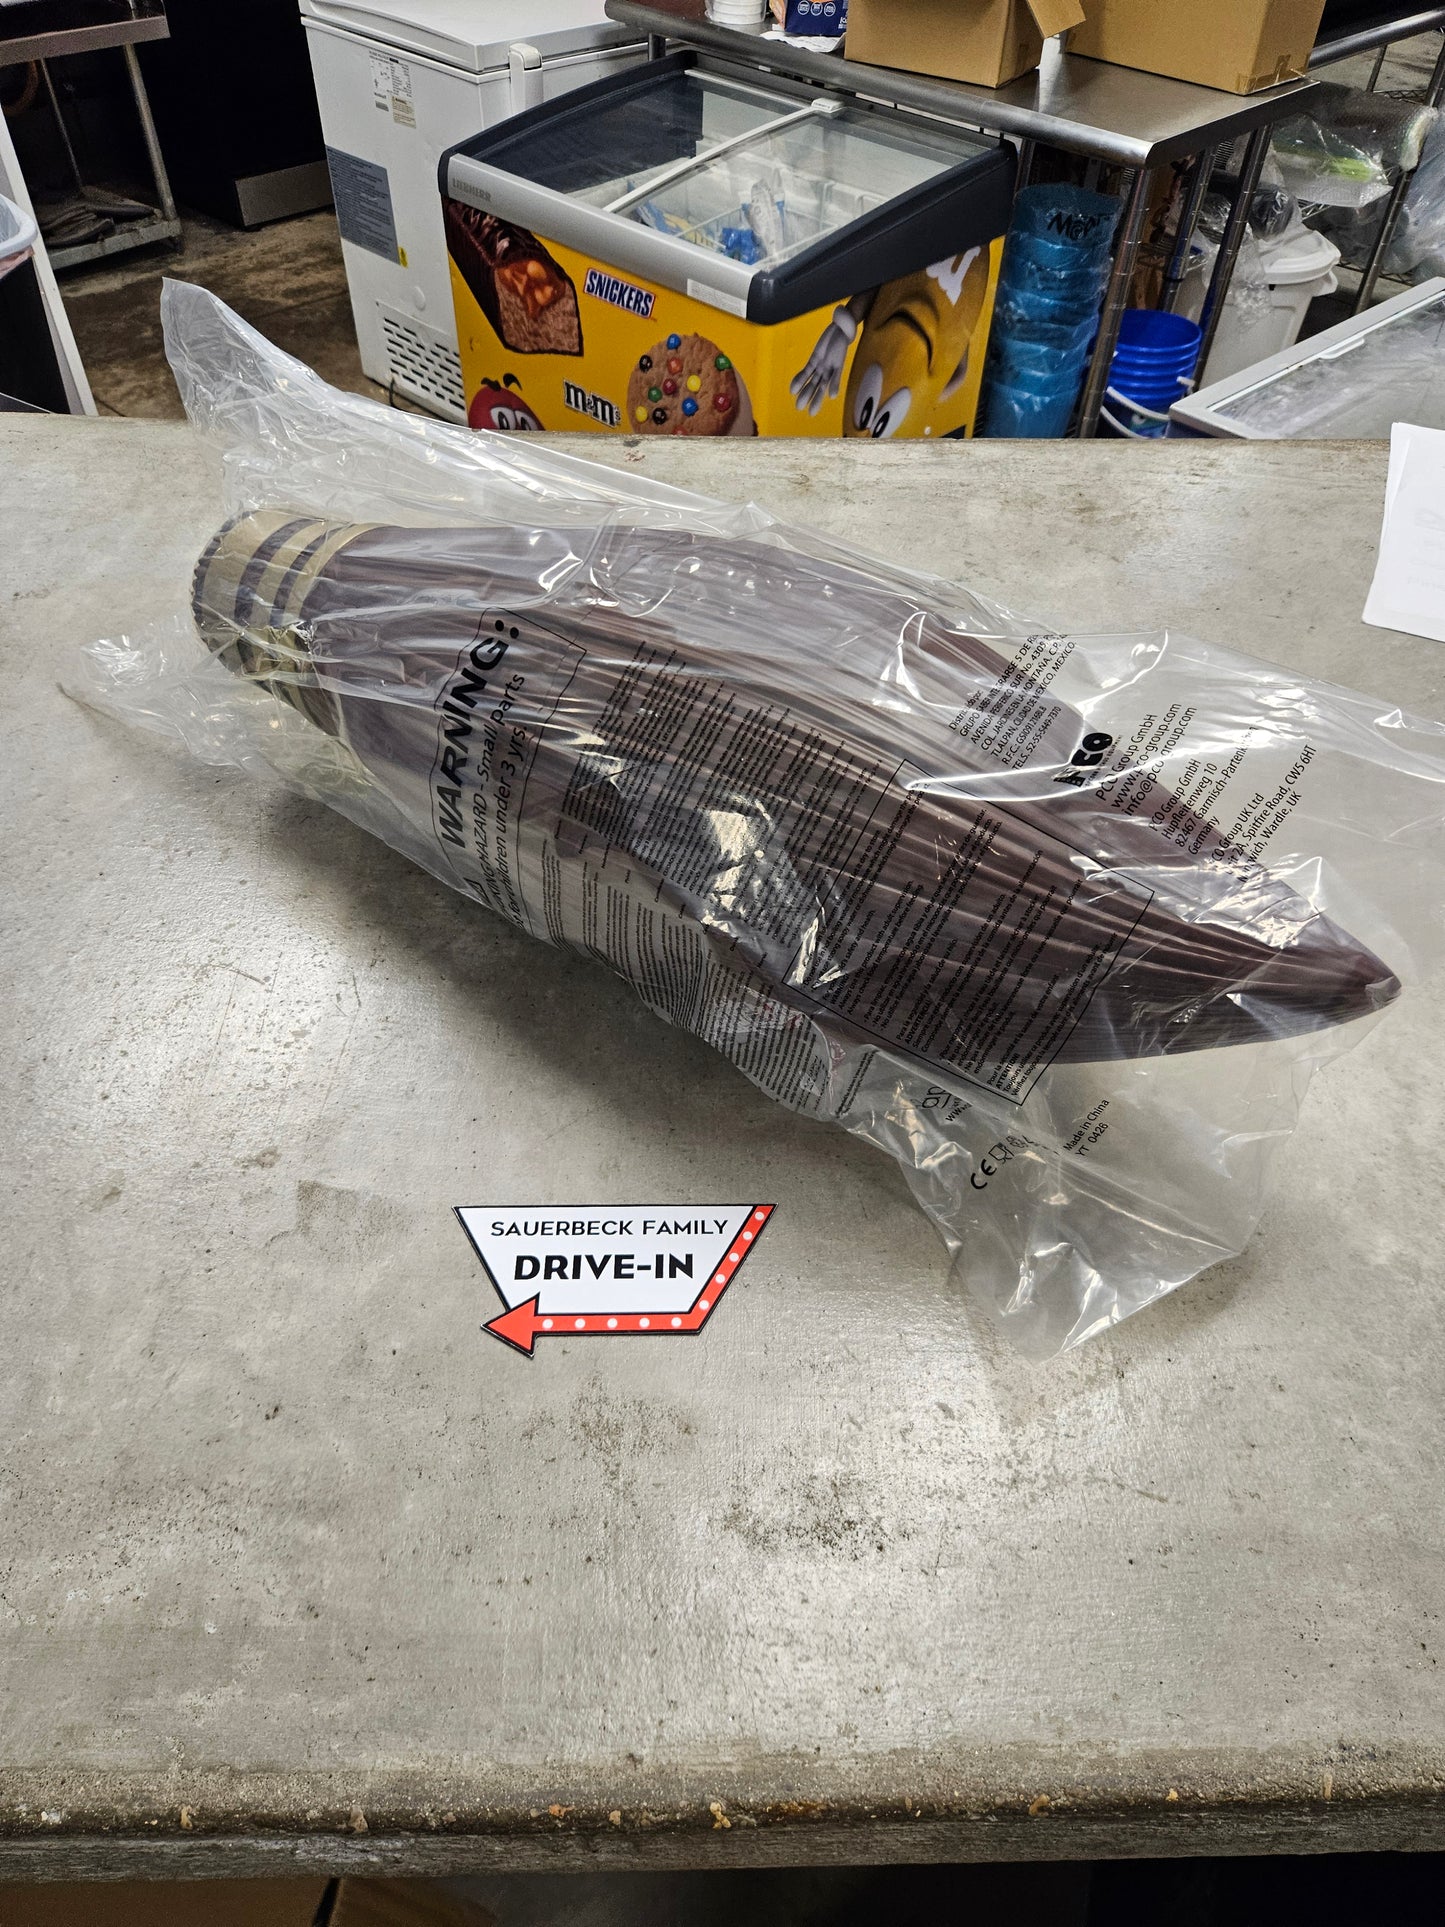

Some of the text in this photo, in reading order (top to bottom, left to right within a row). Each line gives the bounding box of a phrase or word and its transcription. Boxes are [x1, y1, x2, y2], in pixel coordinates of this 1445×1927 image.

[586, 269, 654, 317] SNICKERS
[1019, 653, 1052, 695] MONTAÑA,
[1046, 640, 1061, 656] C.P.
[490, 674, 525, 727] parts
[958, 710, 980, 737] GRUPO
[1013, 654, 1023, 662] S
[1018, 642, 1031, 656] DE
[968, 712, 995, 745] AVENIDA
[1009, 672, 1024, 689] SUR
[1019, 659, 1034, 675] No.
[1014, 691, 1025, 702] LA
[436, 619, 520, 849] WARNING:
[477, 723, 498, 782] Small
[508, 726, 528, 763] yrs.
[979, 731, 997, 752] COL.
[989, 723, 1019, 759] TLALPAN,
[1011, 703, 1032, 727] CIUDAD
[1025, 695, 1038, 708] DE
[1109, 740, 1141, 776] Group
[1128, 709, 1160, 746] GmbH
[501, 760, 516, 776] 3
[1010, 749, 1030, 772] TELS.
[1121, 703, 1202, 819] info@pcogroup.com
[1158, 783, 1187, 816] Group
[1176, 756, 1202, 788] GmbH
[472, 792, 491, 866] HAZARD
[493, 776, 511, 834] under
[1160, 760, 1218, 842] Hupfleitenweg 10
[1217, 819, 1244, 851] Group
[1235, 806, 1253, 824] UK
[1246, 790, 1265, 810] Ltd
[1231, 838, 1249, 857] 2A,
[1240, 805, 1271, 843] Spitfire
[1265, 781, 1291, 812] Road,
[1282, 761, 1305, 787] CW5
[1296, 743, 1317, 765] 6HT
[1260, 801, 1293, 842] Wardle,
[1285, 789, 1302, 807] UK
[1173, 817, 1198, 848] 82467
[1186, 813, 1221, 857] Germany
[825, 804, 917, 962] strong soapy water dishwasher which might damage the
[826, 799, 908, 942] boiling water microwave which might damage the
[862, 807, 988, 1019] Para agua tibia guardar.
[906, 820, 1003, 984] agua jabonosa producto.
[1009, 883, 1059, 959] micro-ondes pourrait
[836, 878, 915, 1010] Always this product with adult supervision.
[843, 908, 875, 959] safety and health.
[845, 906, 910, 1015] Always check food temperature before
[875, 896, 947, 1015] utilizar agua microondas
[920, 848, 1043, 1054] Compruebe siempre temperatura comida antes alimentación
[828, 972, 851, 1005] WARNING!
[895, 936, 960, 1040] Para salud hijo.
[911, 892, 1005, 1049] Siempre este producto supervisión adulto.
[1020, 961, 1033, 978] forte
[902, 999, 932, 1044] ADVERTENCIA!
[939, 965, 997, 1058] Pour tiède
[986, 993, 1048, 1085] Pour votre
[1002, 962, 1088, 1094] Toujours utiliser produit supervision d'un
[1010, 961, 1100, 1098] Vérifiez toujours aliments avant
[994, 1051, 1020, 1089] ATTENTION!
[1063, 1098, 1111, 1152] Made in China
[1074, 1121, 1109, 1157] YT 0426
[491, 1219, 728, 1237] SAUERBECK FAMILY
[513, 1253, 694, 1281] DRIVE-IN
